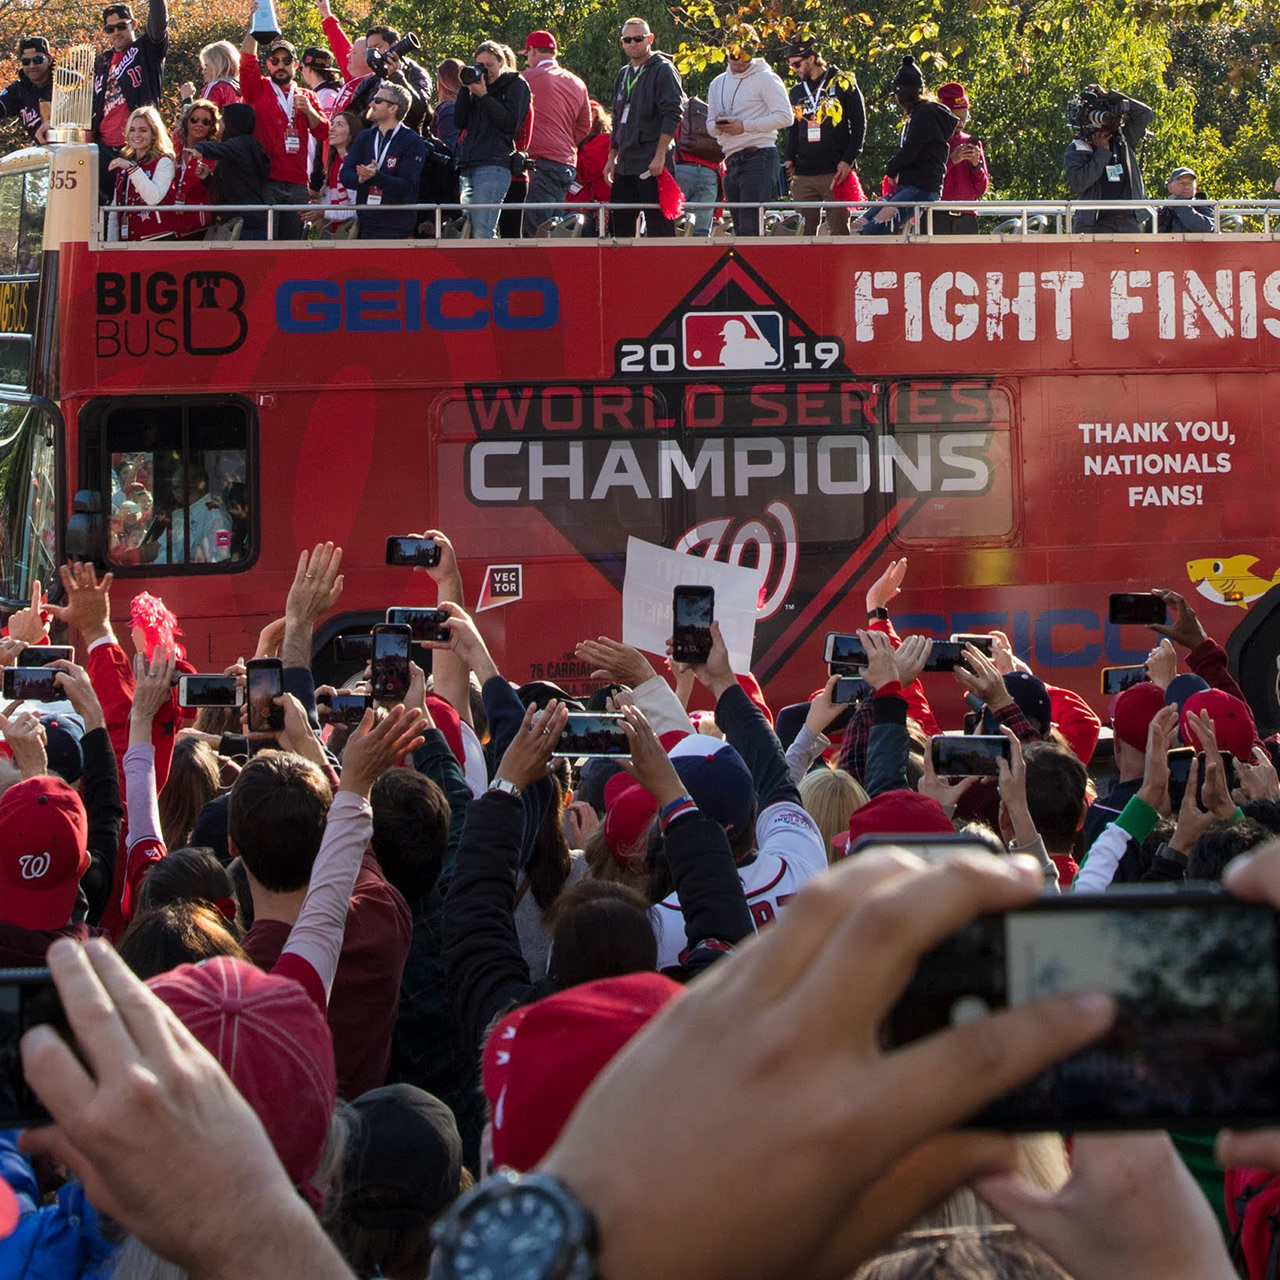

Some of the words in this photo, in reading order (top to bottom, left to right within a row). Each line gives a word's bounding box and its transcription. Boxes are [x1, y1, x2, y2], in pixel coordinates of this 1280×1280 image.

[94, 270, 180, 316] BIG
[274, 277, 560, 334] GEICO
[854, 270, 1085, 343] FIGHT
[95, 317, 180, 359] BUS
[471, 385, 724, 431] WORLD
[750, 382, 990, 427] SERIES
[1077, 421, 1170, 444] THANK
[1174, 420, 1237, 446] YOU,
[469, 433, 991, 502] CHAMPIONS
[1083, 452, 1233, 476] NATIONALS
[1128, 484, 1204, 507] FANS!
[493, 572, 517, 582] VEC
[494, 583, 517, 592] TOR
[529, 663, 545, 679] 76
